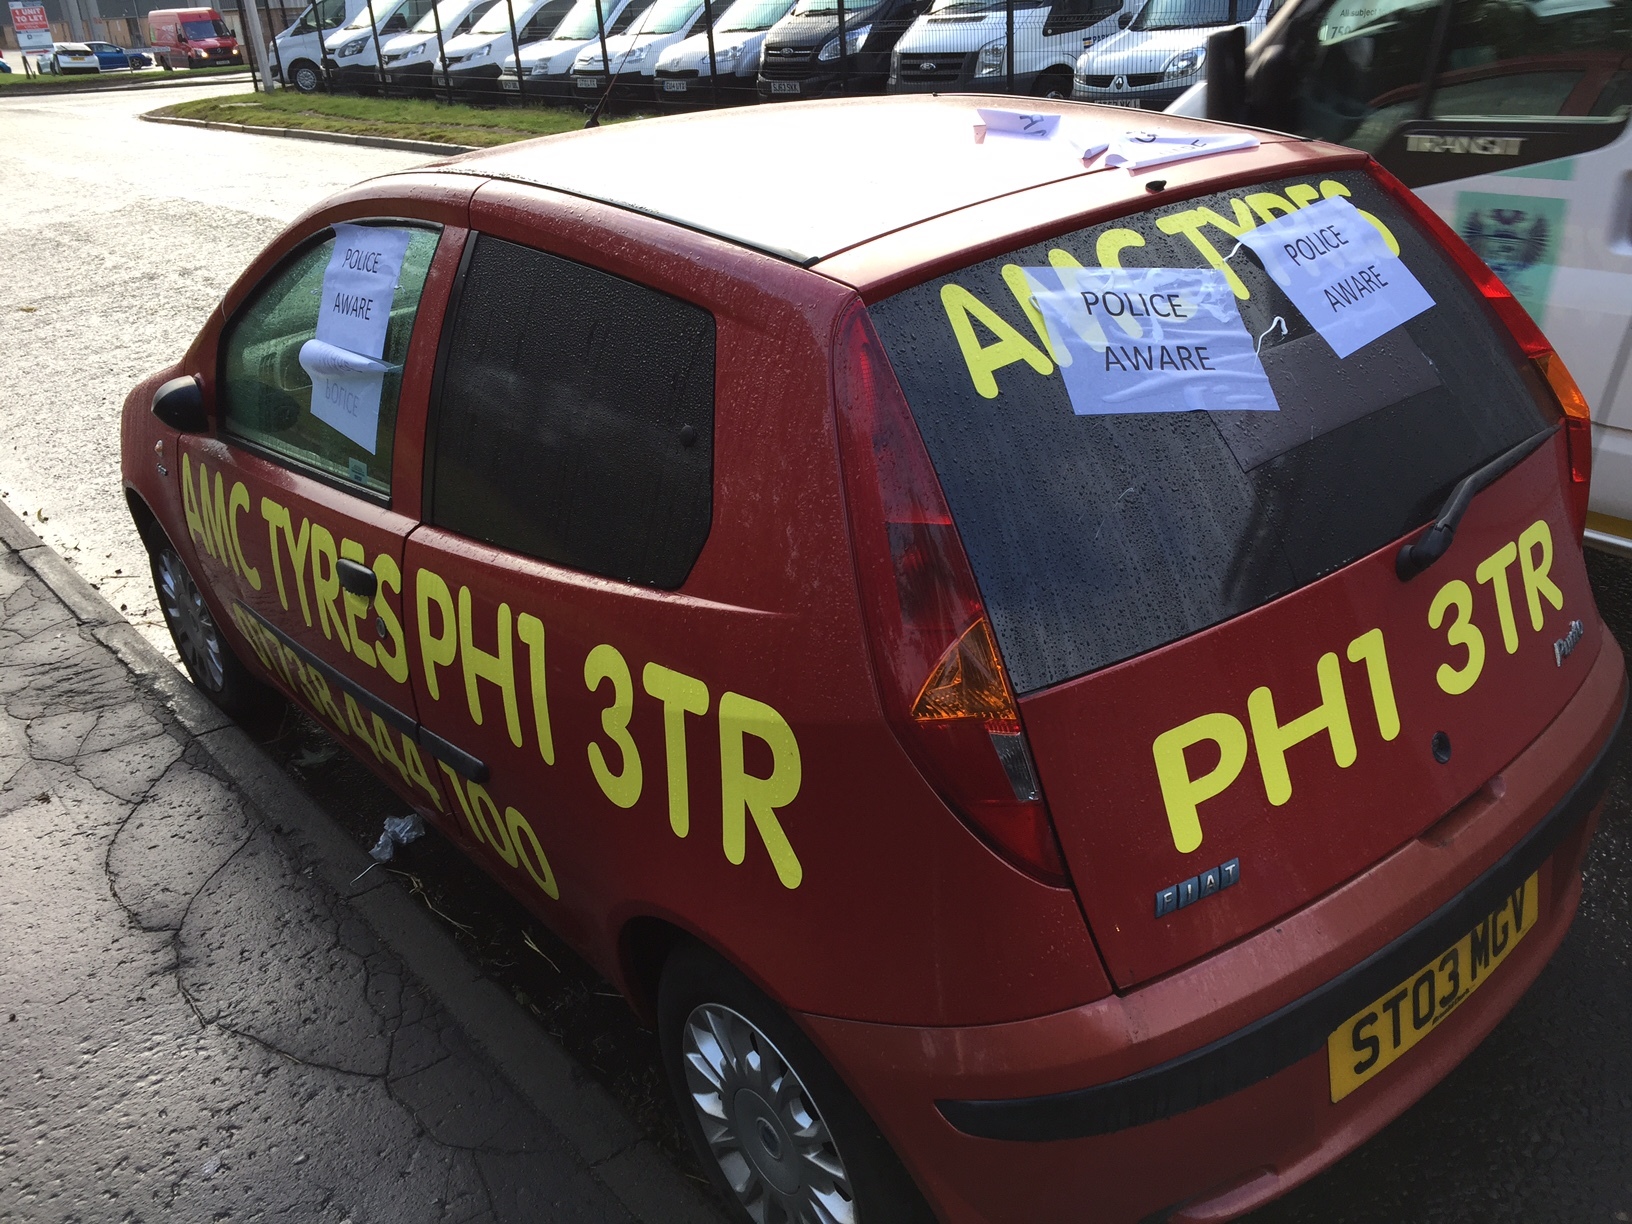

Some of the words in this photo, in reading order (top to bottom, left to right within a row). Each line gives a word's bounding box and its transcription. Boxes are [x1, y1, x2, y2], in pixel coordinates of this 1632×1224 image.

[1351, 9, 1377, 19] subject
[342, 249, 382, 274] POLICE
[1283, 225, 1349, 267] POLICE
[333, 293, 373, 320] AWARE
[1081, 291, 1188, 318] POLICE
[1323, 265, 1389, 313] AWARE
[1105, 346, 1216, 372] AWARE
[182, 453, 262, 590] AMC
[261, 497, 409, 684] TYRES
[1152, 627, 1401, 853] PH1
[1428, 520, 1564, 695] 3TR
[416, 568, 555, 766] PH1
[584, 643, 803, 889] 3TR
[1162, 863, 1237, 913] FIAT
[1470, 882, 1526, 982] MGV
